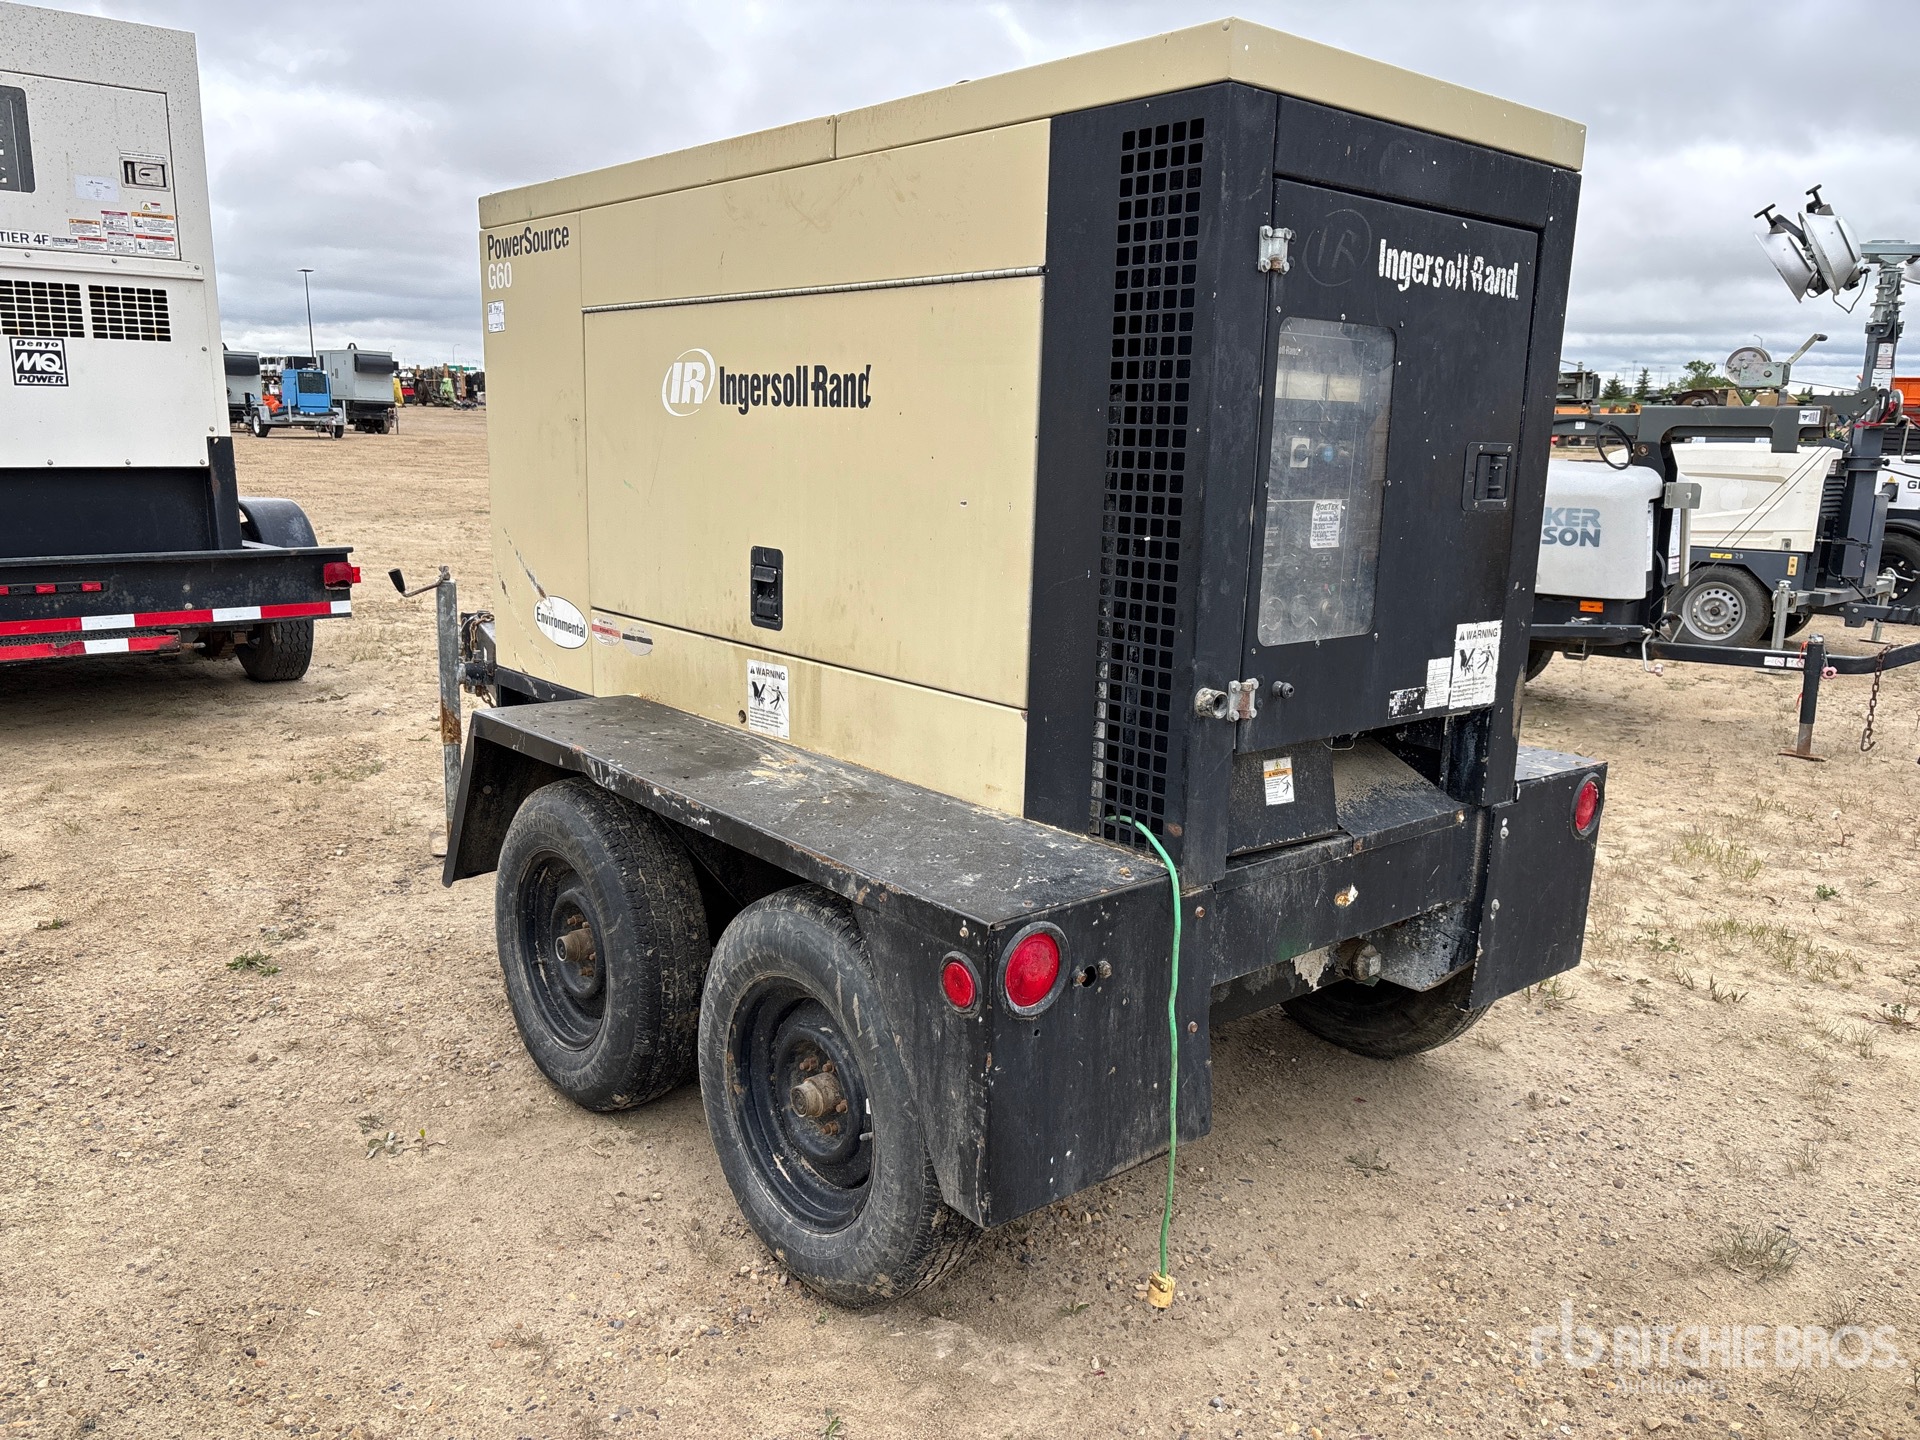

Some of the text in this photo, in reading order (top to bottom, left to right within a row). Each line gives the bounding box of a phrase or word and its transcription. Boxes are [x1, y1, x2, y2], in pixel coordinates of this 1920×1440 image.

[0, 231, 29, 244] TIER
[33, 233, 49, 245] 4F
[487, 226, 569, 260] PowerSource
[488, 262, 512, 290] G60
[1378, 239, 1468, 292] Ingersoll
[16, 339, 59, 349] Denyo
[16, 352, 63, 374] MQ
[18, 374, 64, 384] POWER
[670, 362, 706, 404] IR
[719, 366, 808, 415] Ingersoll
[1544, 507, 1602, 528] KER
[1541, 527, 1602, 547] SON
[536, 606, 586, 638] Environmental
[1466, 628, 1498, 640] WARNING
[756, 667, 786, 681] WARNING
